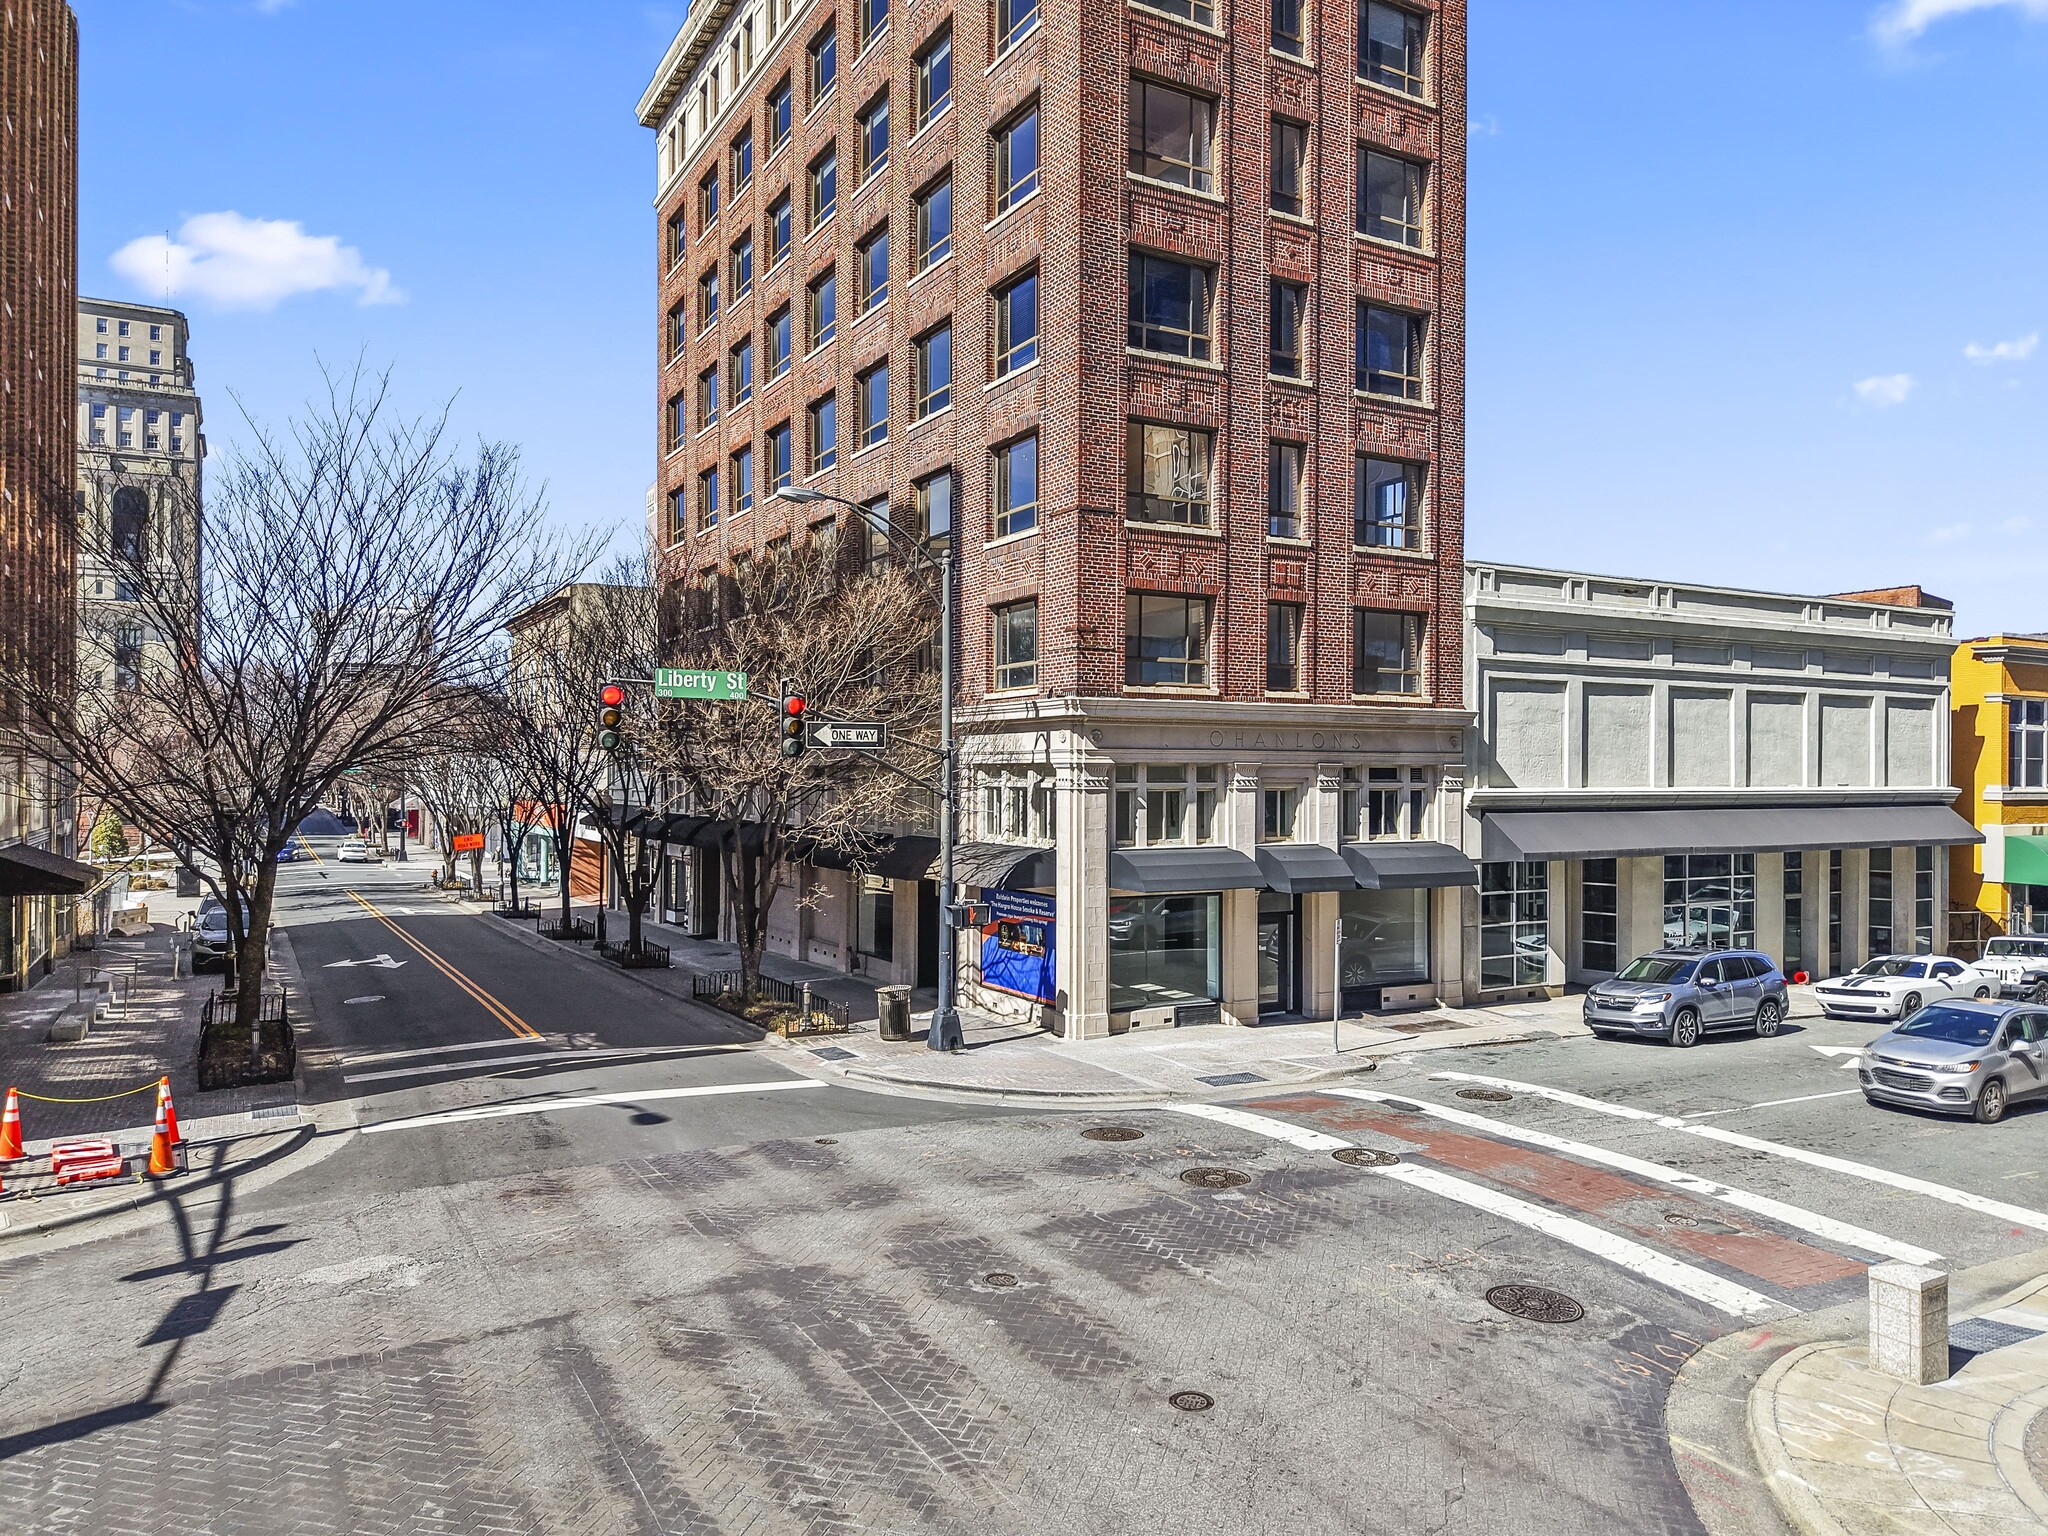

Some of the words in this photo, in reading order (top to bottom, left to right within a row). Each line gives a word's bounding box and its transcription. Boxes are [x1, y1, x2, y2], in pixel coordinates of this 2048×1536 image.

[658, 670, 717, 692] Liberty
[726, 672, 744, 690] St
[658, 689, 673, 697] 300
[730, 692, 744, 700] 400
[831, 730, 852, 741] ONE
[855, 730, 876, 741] WAY
[1010, 895, 1030, 904] Properties
